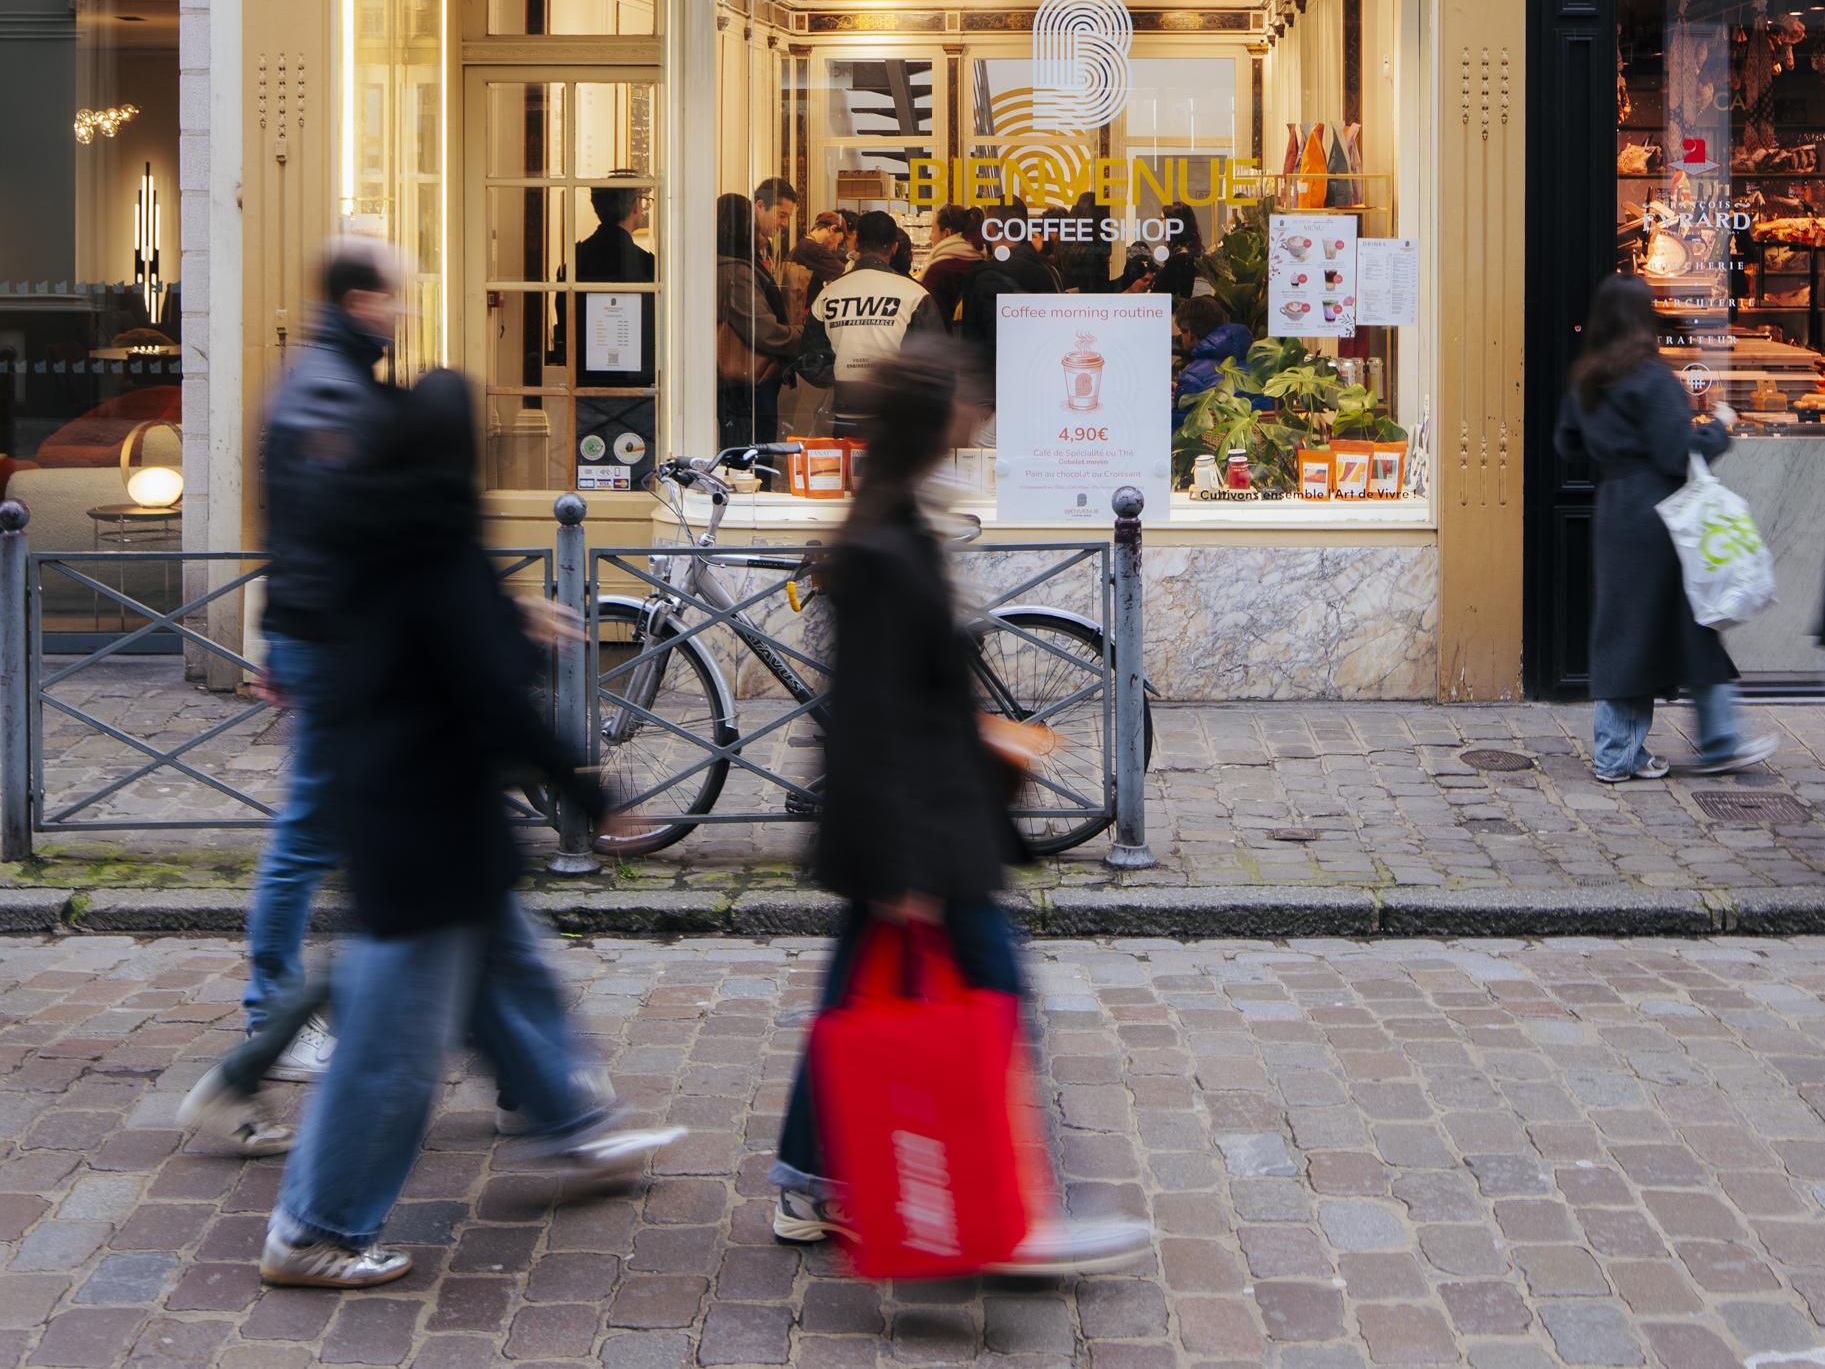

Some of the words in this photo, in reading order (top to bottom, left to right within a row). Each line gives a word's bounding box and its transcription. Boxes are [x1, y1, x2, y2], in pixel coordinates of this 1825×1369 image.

[908, 157, 1259, 207] BIENVENUE
[981, 217, 1093, 243] COFFEE
[1099, 217, 1185, 243] SHOP
[1362, 240, 1387, 248] DRINKS
[1001, 305, 1046, 319] Coffee
[1051, 306, 1109, 321] morning
[1113, 306, 1164, 319] routine
[1058, 426, 1109, 443] 4,90€
[1033, 448, 1052, 457] Café
[1053, 448, 1063, 457] de
[1065, 447, 1104, 459] Spécialité
[1118, 447, 1134, 457] Thé
[1025, 470, 1043, 478] Pain
[1056, 470, 1090, 478] chocolat
[1103, 470, 1142, 478] Croissant
[1200, 489, 1259, 500] Cultivons
[1262, 488, 1324, 500] ensemble
[1327, 487, 1349, 500] l'Art
[1358, 488, 1375, 500] de
[1376, 488, 1410, 499] Vivre
